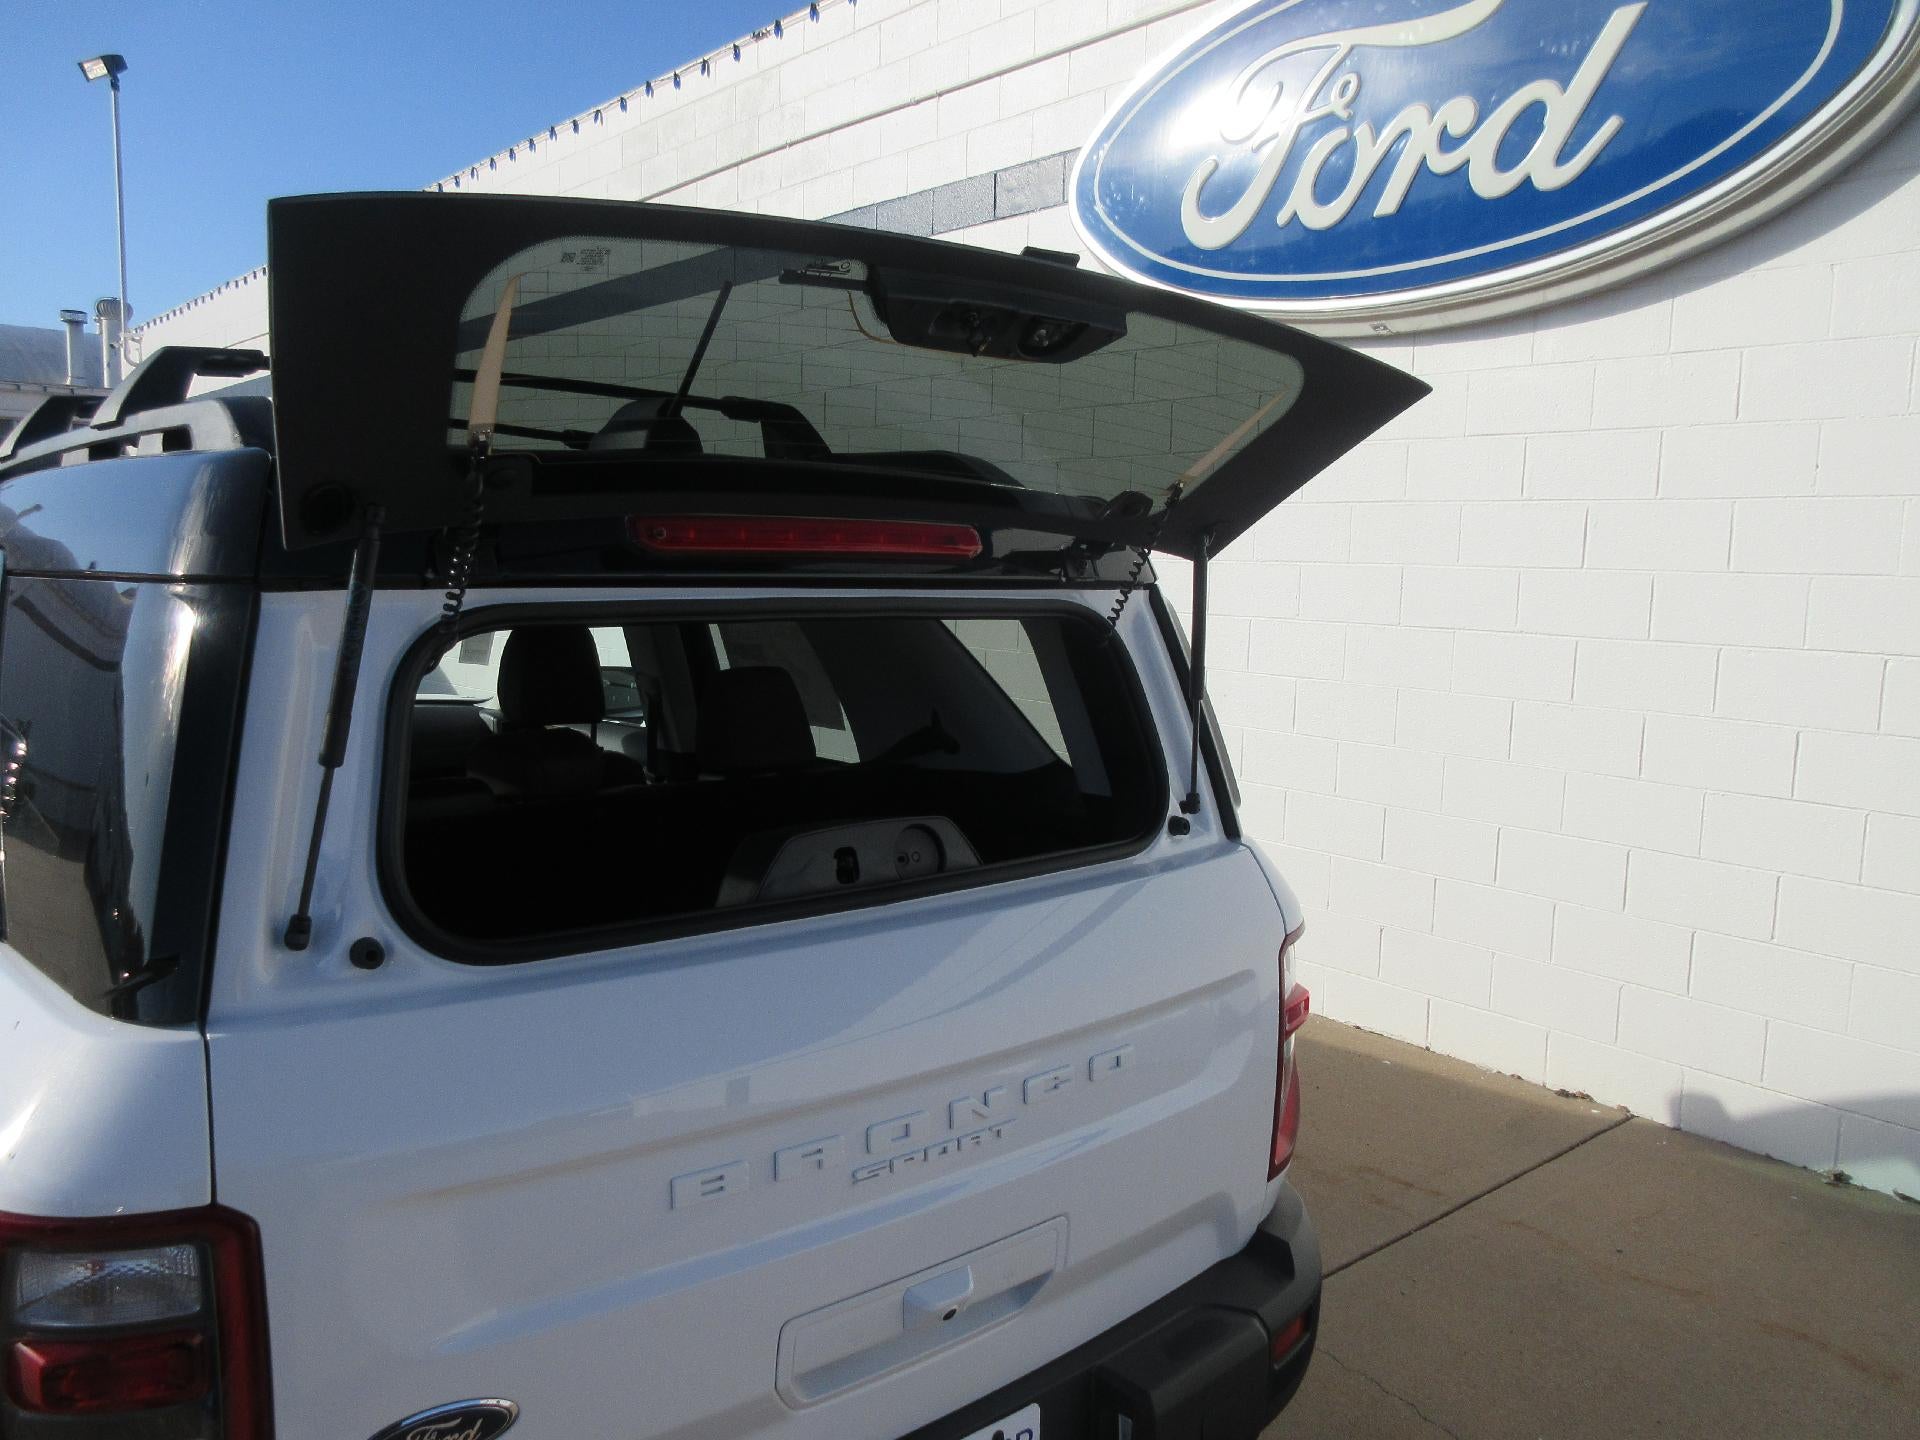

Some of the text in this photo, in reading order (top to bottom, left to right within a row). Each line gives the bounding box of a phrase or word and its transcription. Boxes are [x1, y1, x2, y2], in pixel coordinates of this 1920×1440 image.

[1182, 0, 1645, 250] Ford
[670, 1044, 1133, 1210] BRONCO
[852, 1118, 1016, 1185] SPORT
[406, 1416, 483, 1440] Fd
